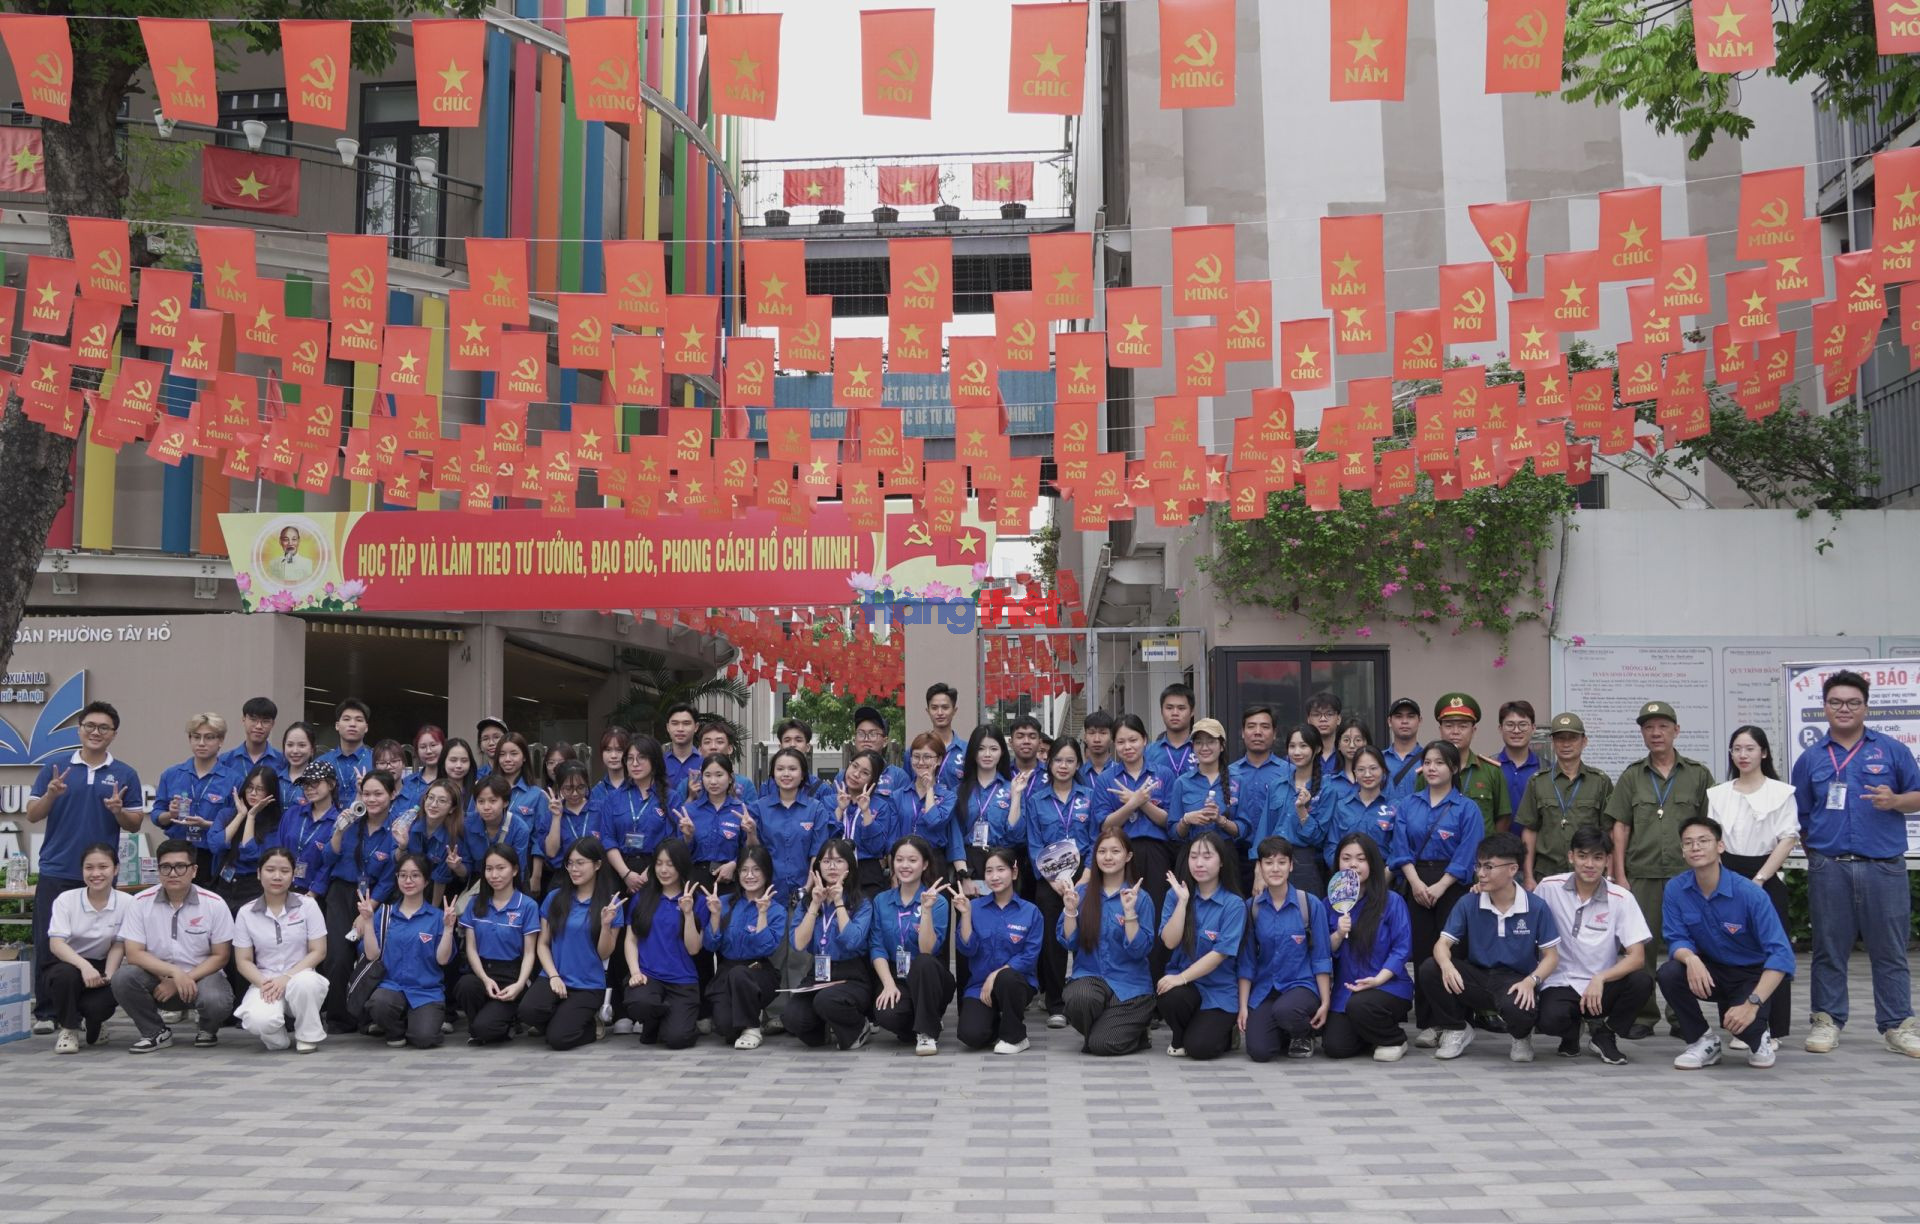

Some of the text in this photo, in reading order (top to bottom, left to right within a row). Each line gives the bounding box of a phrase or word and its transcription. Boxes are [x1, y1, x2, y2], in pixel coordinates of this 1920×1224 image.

[1890, 17, 1920, 38] MỚ
[1708, 38, 1754, 59] NĂM
[1503, 50, 1541, 71] MỚI
[1171, 69, 1224, 89] MỪNG
[1345, 65, 1388, 84] NĂM
[726, 83, 766, 105] NĂM
[1023, 76, 1071, 98] CHÚC
[32, 86, 67, 107] MỪNG
[171, 91, 206, 109] NĂM
[302, 90, 332, 111] MỚI
[433, 93, 473, 113] CHÚC
[588, 92, 636, 112] MỪNG
[1748, 230, 1795, 247] MỪNG
[1612, 248, 1654, 267] CHÚC
[1883, 256, 1911, 270] MỚI
[90, 276, 127, 294] MỪNG
[1184, 282, 1229, 301] MỪNG
[1330, 281, 1367, 296] NĂM
[1776, 276, 1808, 291] NĂM
[215, 286, 248, 303] NĂM
[343, 294, 372, 311] MỚI
[483, 291, 519, 308] CHÚC
[904, 292, 935, 309] MỚI
[1663, 290, 1704, 308] MỪNG
[32, 306, 61, 321] NĂM
[618, 297, 659, 315] MỪNG
[758, 301, 793, 315] NĂM
[1554, 302, 1590, 319] CHÚC
[1848, 298, 1882, 313] MỪNG
[1453, 314, 1482, 330] MỚI
[1739, 312, 1771, 327] CHÚC
[150, 322, 177, 337] MỚI
[245, 327, 279, 345] CHÚC
[1341, 327, 1372, 342] NĂM
[1644, 329, 1670, 344] MỚI
[341, 332, 378, 350] MỪNG
[572, 341, 599, 357] MỚI
[1116, 341, 1152, 355] CHÚC
[1227, 334, 1265, 349] MỪNG
[78, 344, 109, 360] MỪNG
[459, 342, 490, 357] NĂM
[675, 347, 708, 364] CHÚC
[788, 345, 825, 361] MỪNG
[897, 345, 928, 360] NĂM
[1007, 345, 1033, 361] MỚI
[1520, 347, 1549, 361] NĂM
[181, 356, 209, 371] NĂM
[292, 361, 315, 377] MỚI
[1721, 358, 1745, 373] NĂM
[391, 371, 420, 385] CHÚC
[508, 378, 542, 393] MỪNG
[31, 378, 60, 395] CHÚC
[627, 383, 654, 397] NĂM
[737, 381, 761, 397] MỚI
[843, 383, 874, 398] CHÚC
[958, 382, 991, 397] MỪNG
[1627, 382, 1658, 396] MỪNG
[122, 398, 152, 413] MỪNG
[1536, 391, 1565, 406] CHÚC
[1661, 404, 1685, 418] CHÚC
[159, 444, 182, 458] MỪNG
[358, 544, 386, 584] HỌC
[390, 536, 416, 585] TẬP
[420, 535, 438, 577] VÀ
[442, 536, 472, 577] LÀM
[476, 540, 511, 576] THEO
[515, 538, 535, 575] TƯ
[537, 530, 587, 578] TƯỞNG,
[591, 540, 620, 582] ĐẠO
[624, 532, 658, 577] ĐỨC,
[662, 539, 712, 573] PHONG
[715, 527, 755, 572] CÁCH
[758, 526, 780, 572] HỒ
[783, 530, 807, 570] CHÍ
[49, 624, 113, 642] PHƯỜNG
[118, 624, 143, 641] TÂY
[147, 620, 171, 640] HỒ
[8, 670, 33, 684] XUÂN
[1876, 667, 1908, 685] BÁO
[30, 689, 44, 703] NỘI
